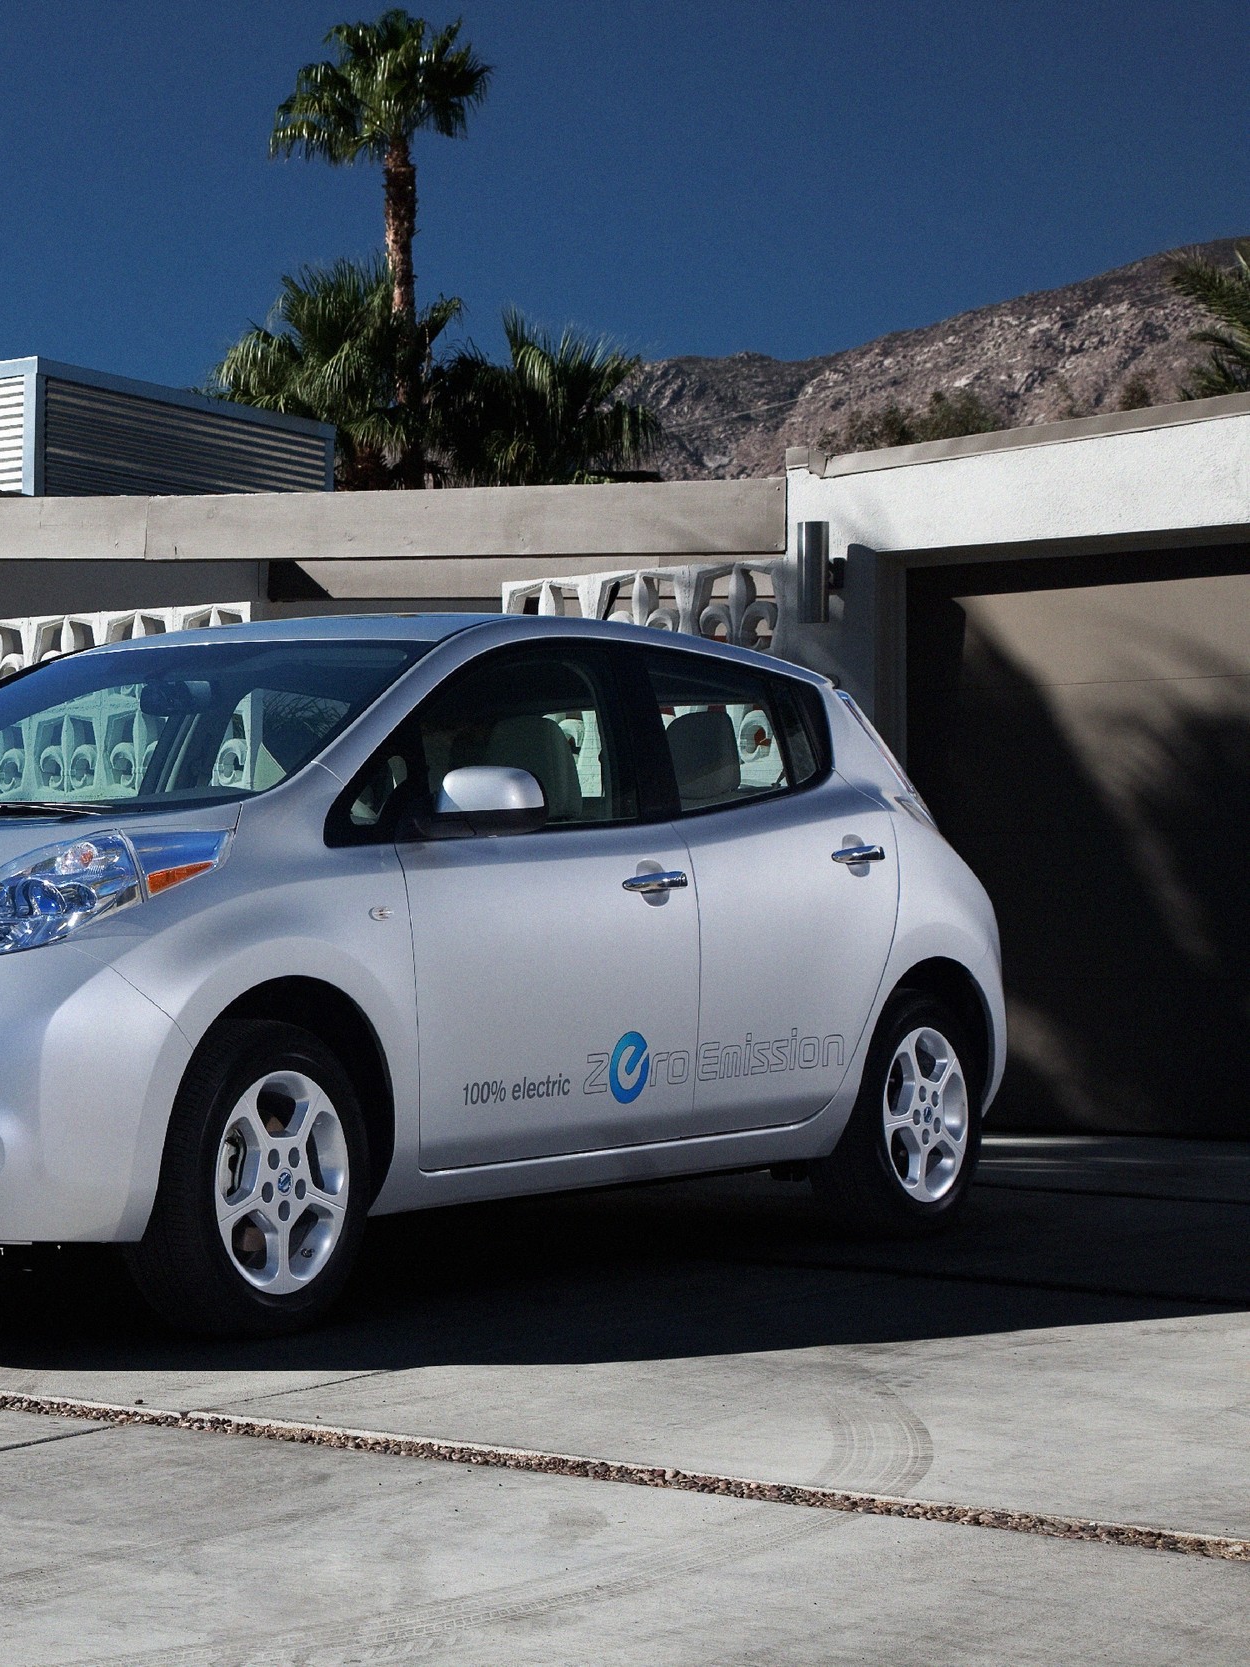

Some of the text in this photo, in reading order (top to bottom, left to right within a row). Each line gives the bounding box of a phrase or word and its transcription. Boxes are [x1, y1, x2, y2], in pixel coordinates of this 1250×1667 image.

[696, 1027, 845, 1082] Emission
[462, 1073, 571, 1107] 100% electric
